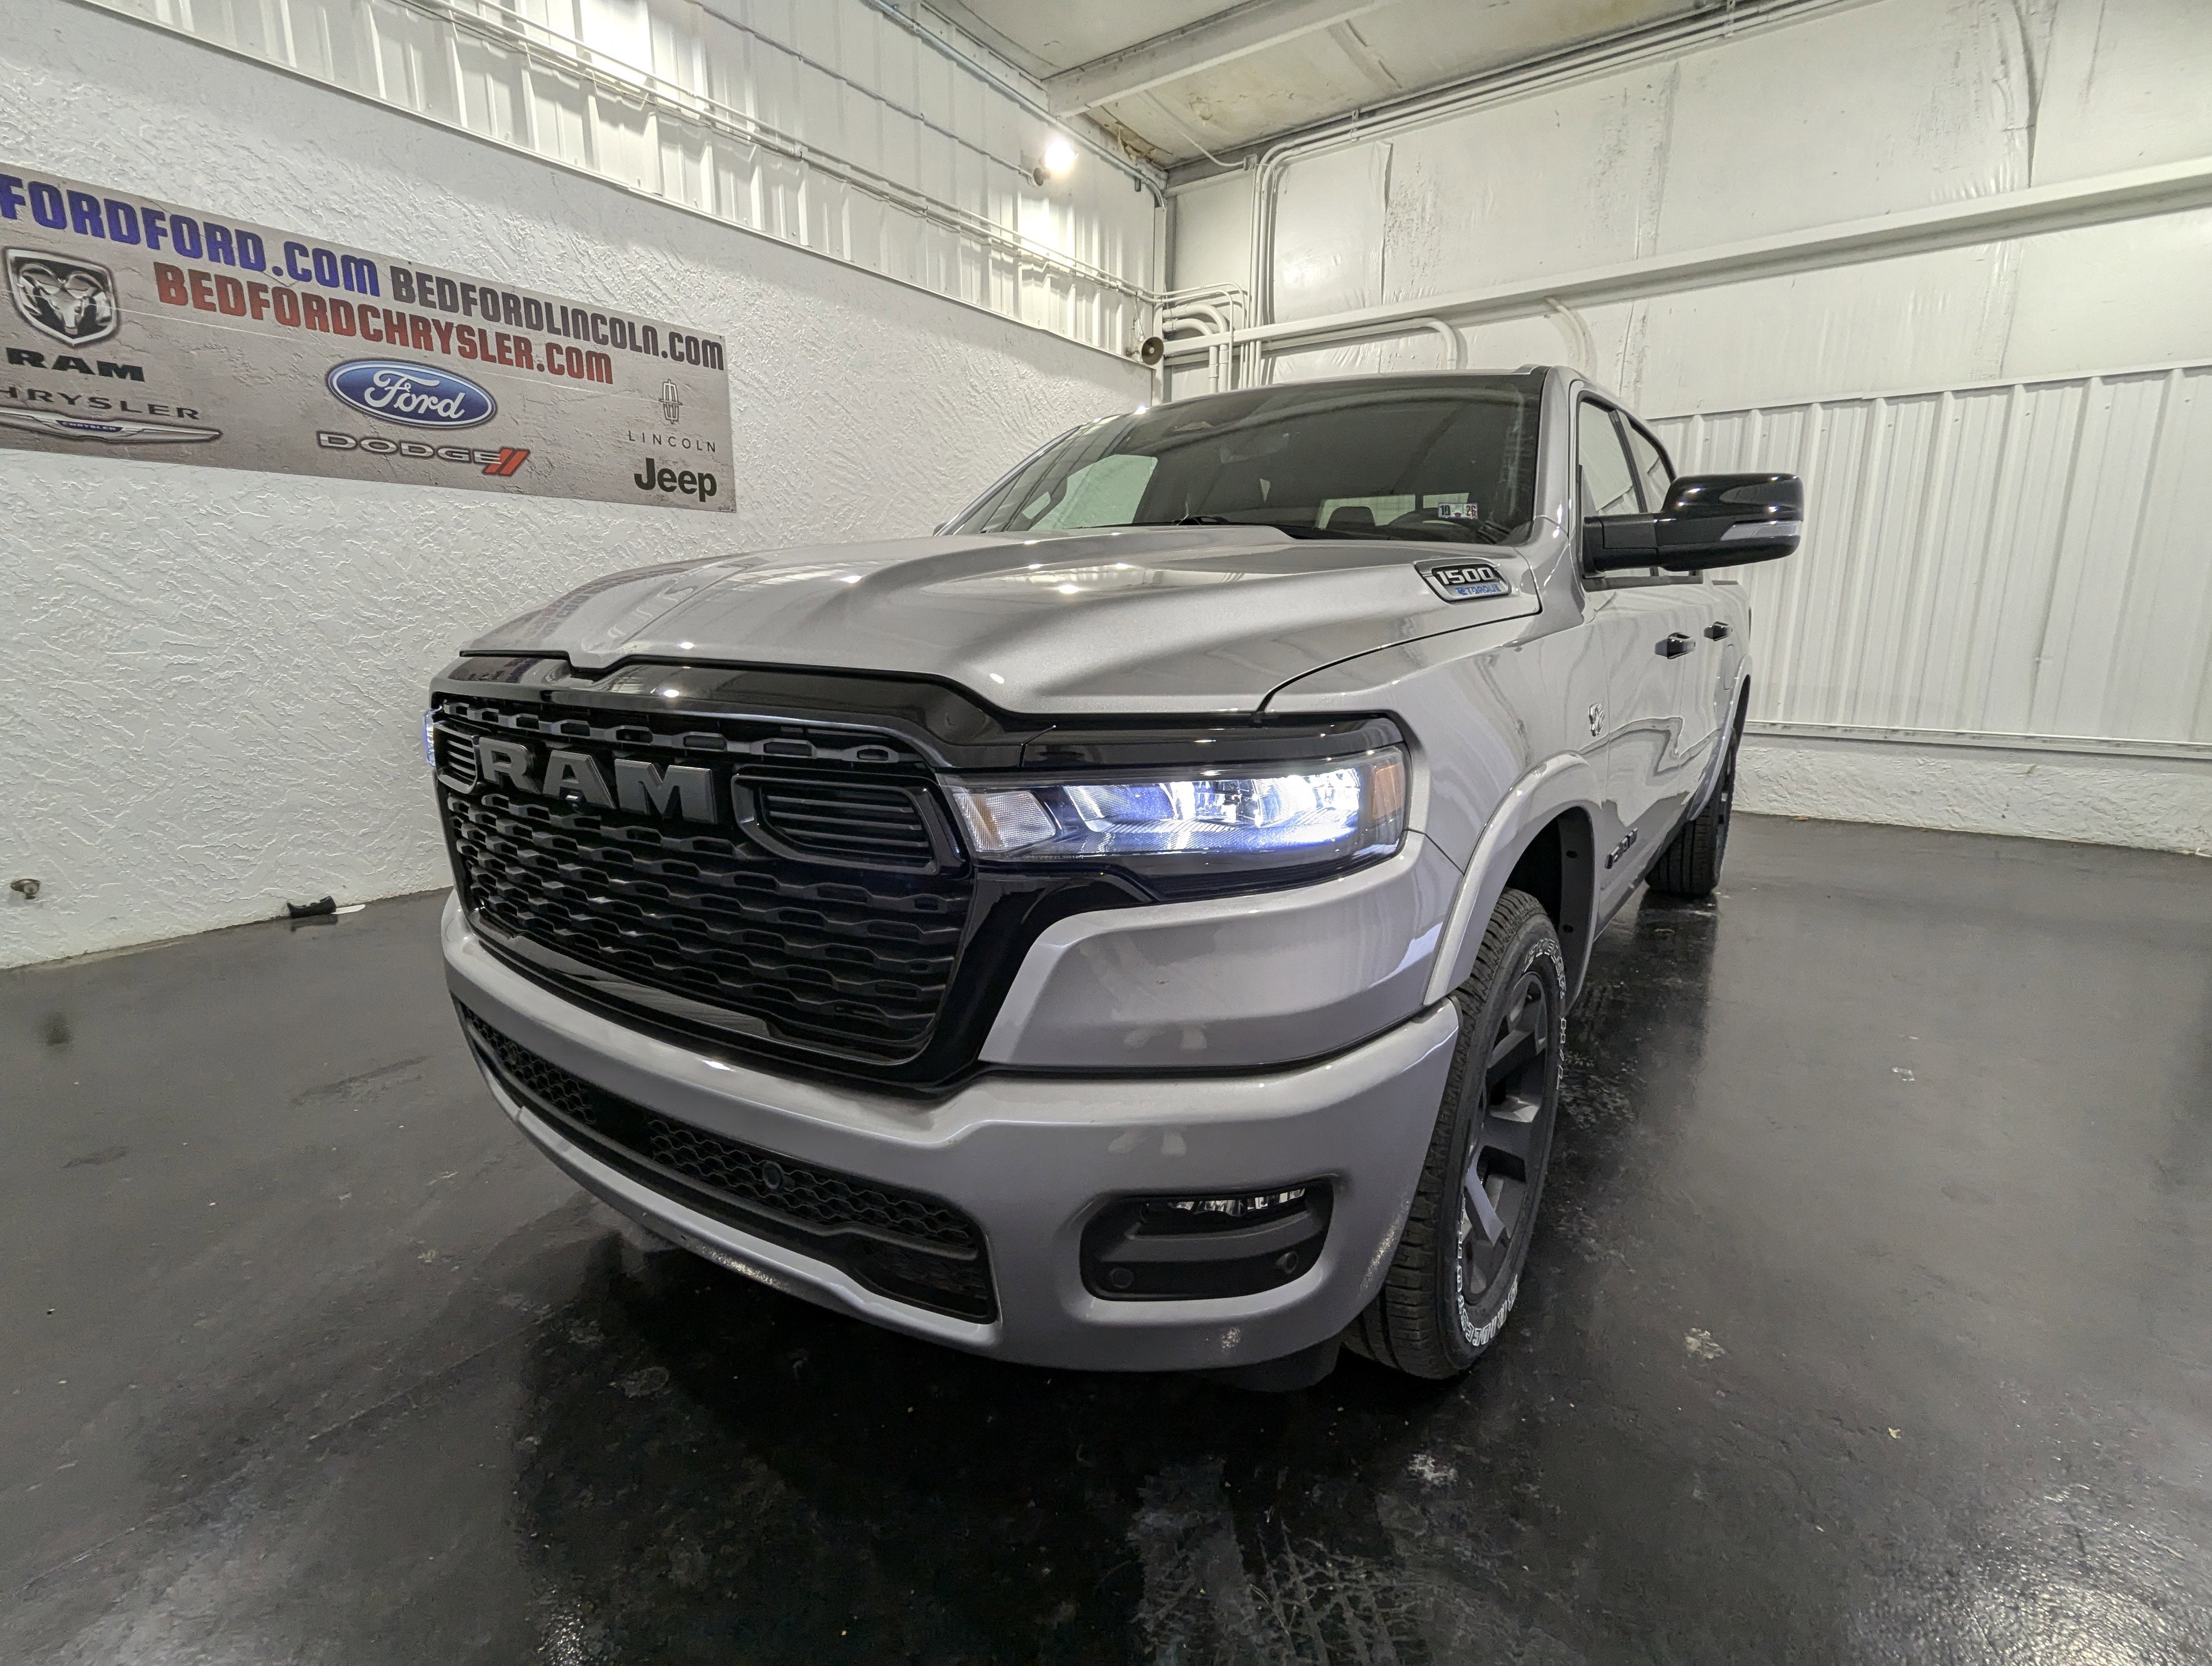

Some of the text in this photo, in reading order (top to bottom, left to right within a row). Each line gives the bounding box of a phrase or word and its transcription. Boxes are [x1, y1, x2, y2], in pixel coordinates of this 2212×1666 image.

[153, 261, 613, 384] BEDFORDCHRYSLER.COM
[390, 266, 724, 370] BEDFORDLINCOLN.COM
[6, 348, 145, 382] RAM
[364, 370, 465, 419] Ford
[318, 433, 503, 465] DODGE
[628, 430, 716, 452] LINCOLN
[634, 457, 717, 502] Jeep
[1437, 567, 1495, 585] 1500
[479, 736, 718, 824] RAM
